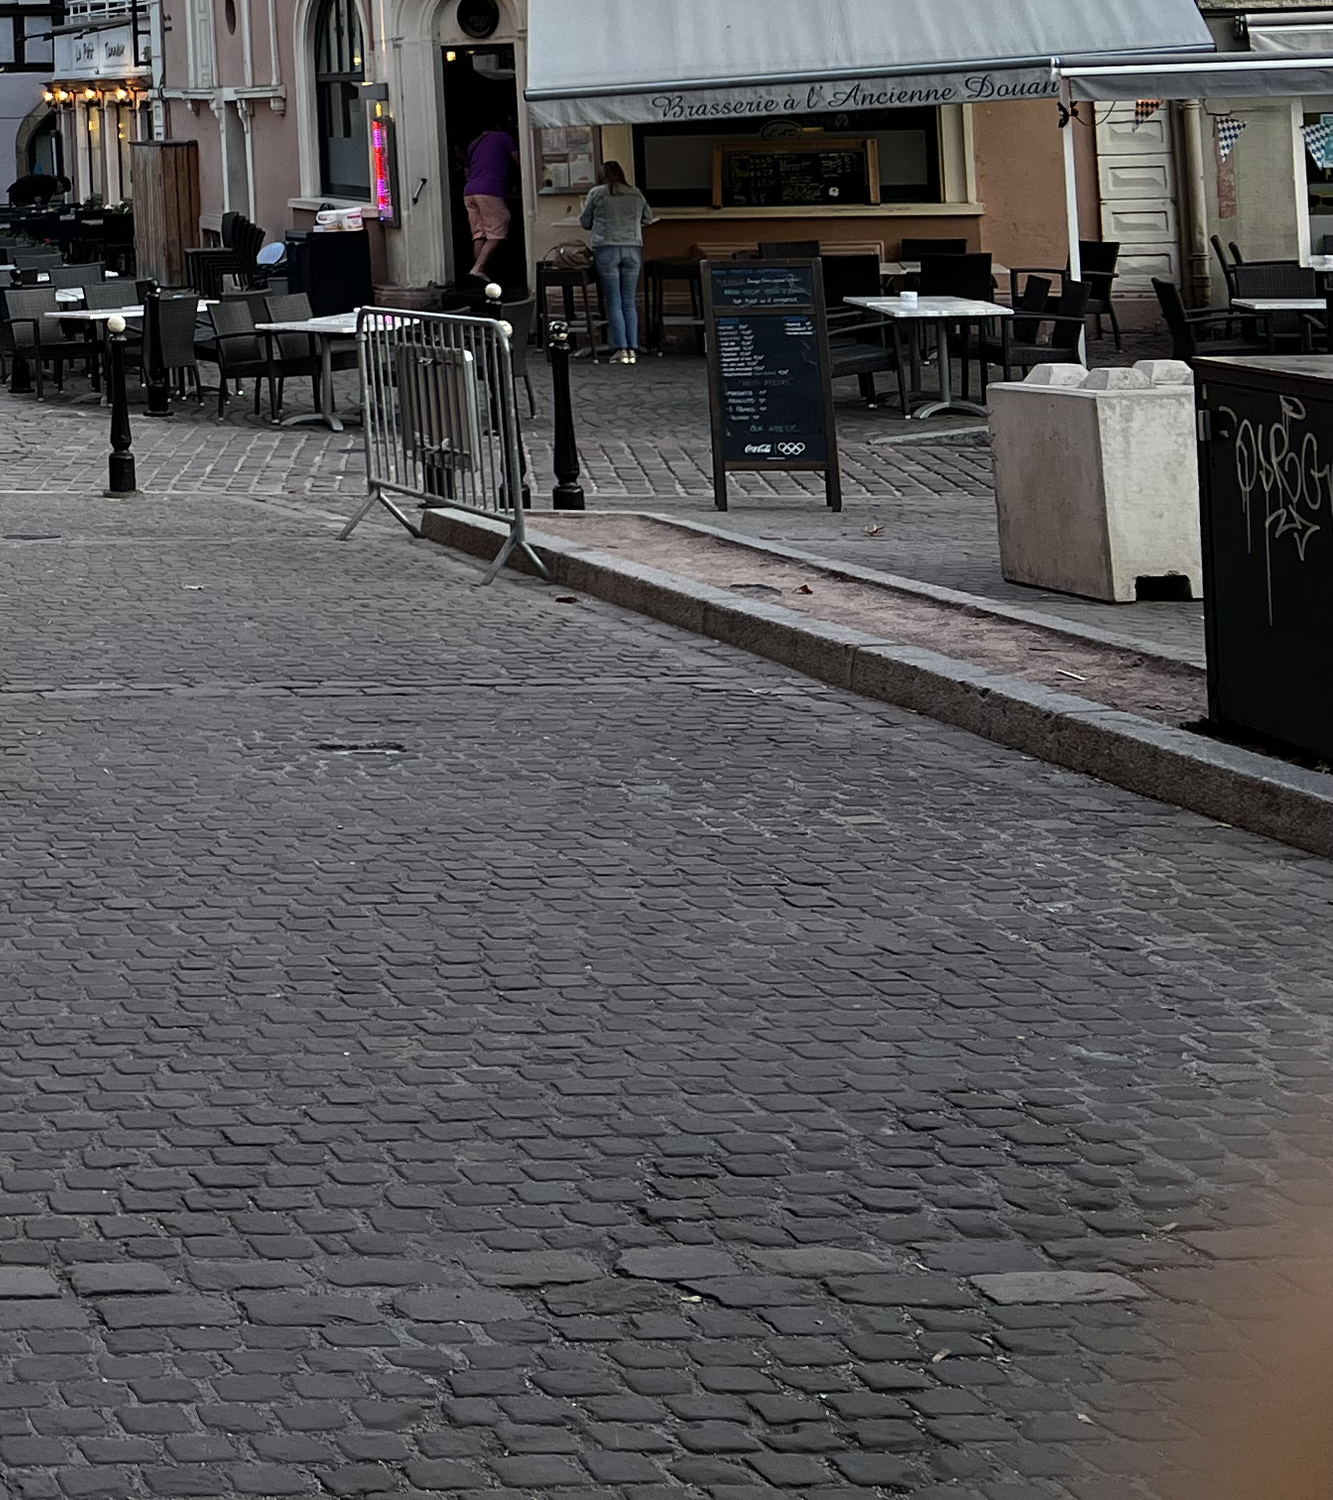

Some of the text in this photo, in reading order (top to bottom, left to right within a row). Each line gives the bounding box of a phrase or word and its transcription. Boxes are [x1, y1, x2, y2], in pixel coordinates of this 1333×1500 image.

[651, 95, 779, 118] Brasserie
[784, 94, 801, 110] à
[964, 74, 1060, 99] Douan
